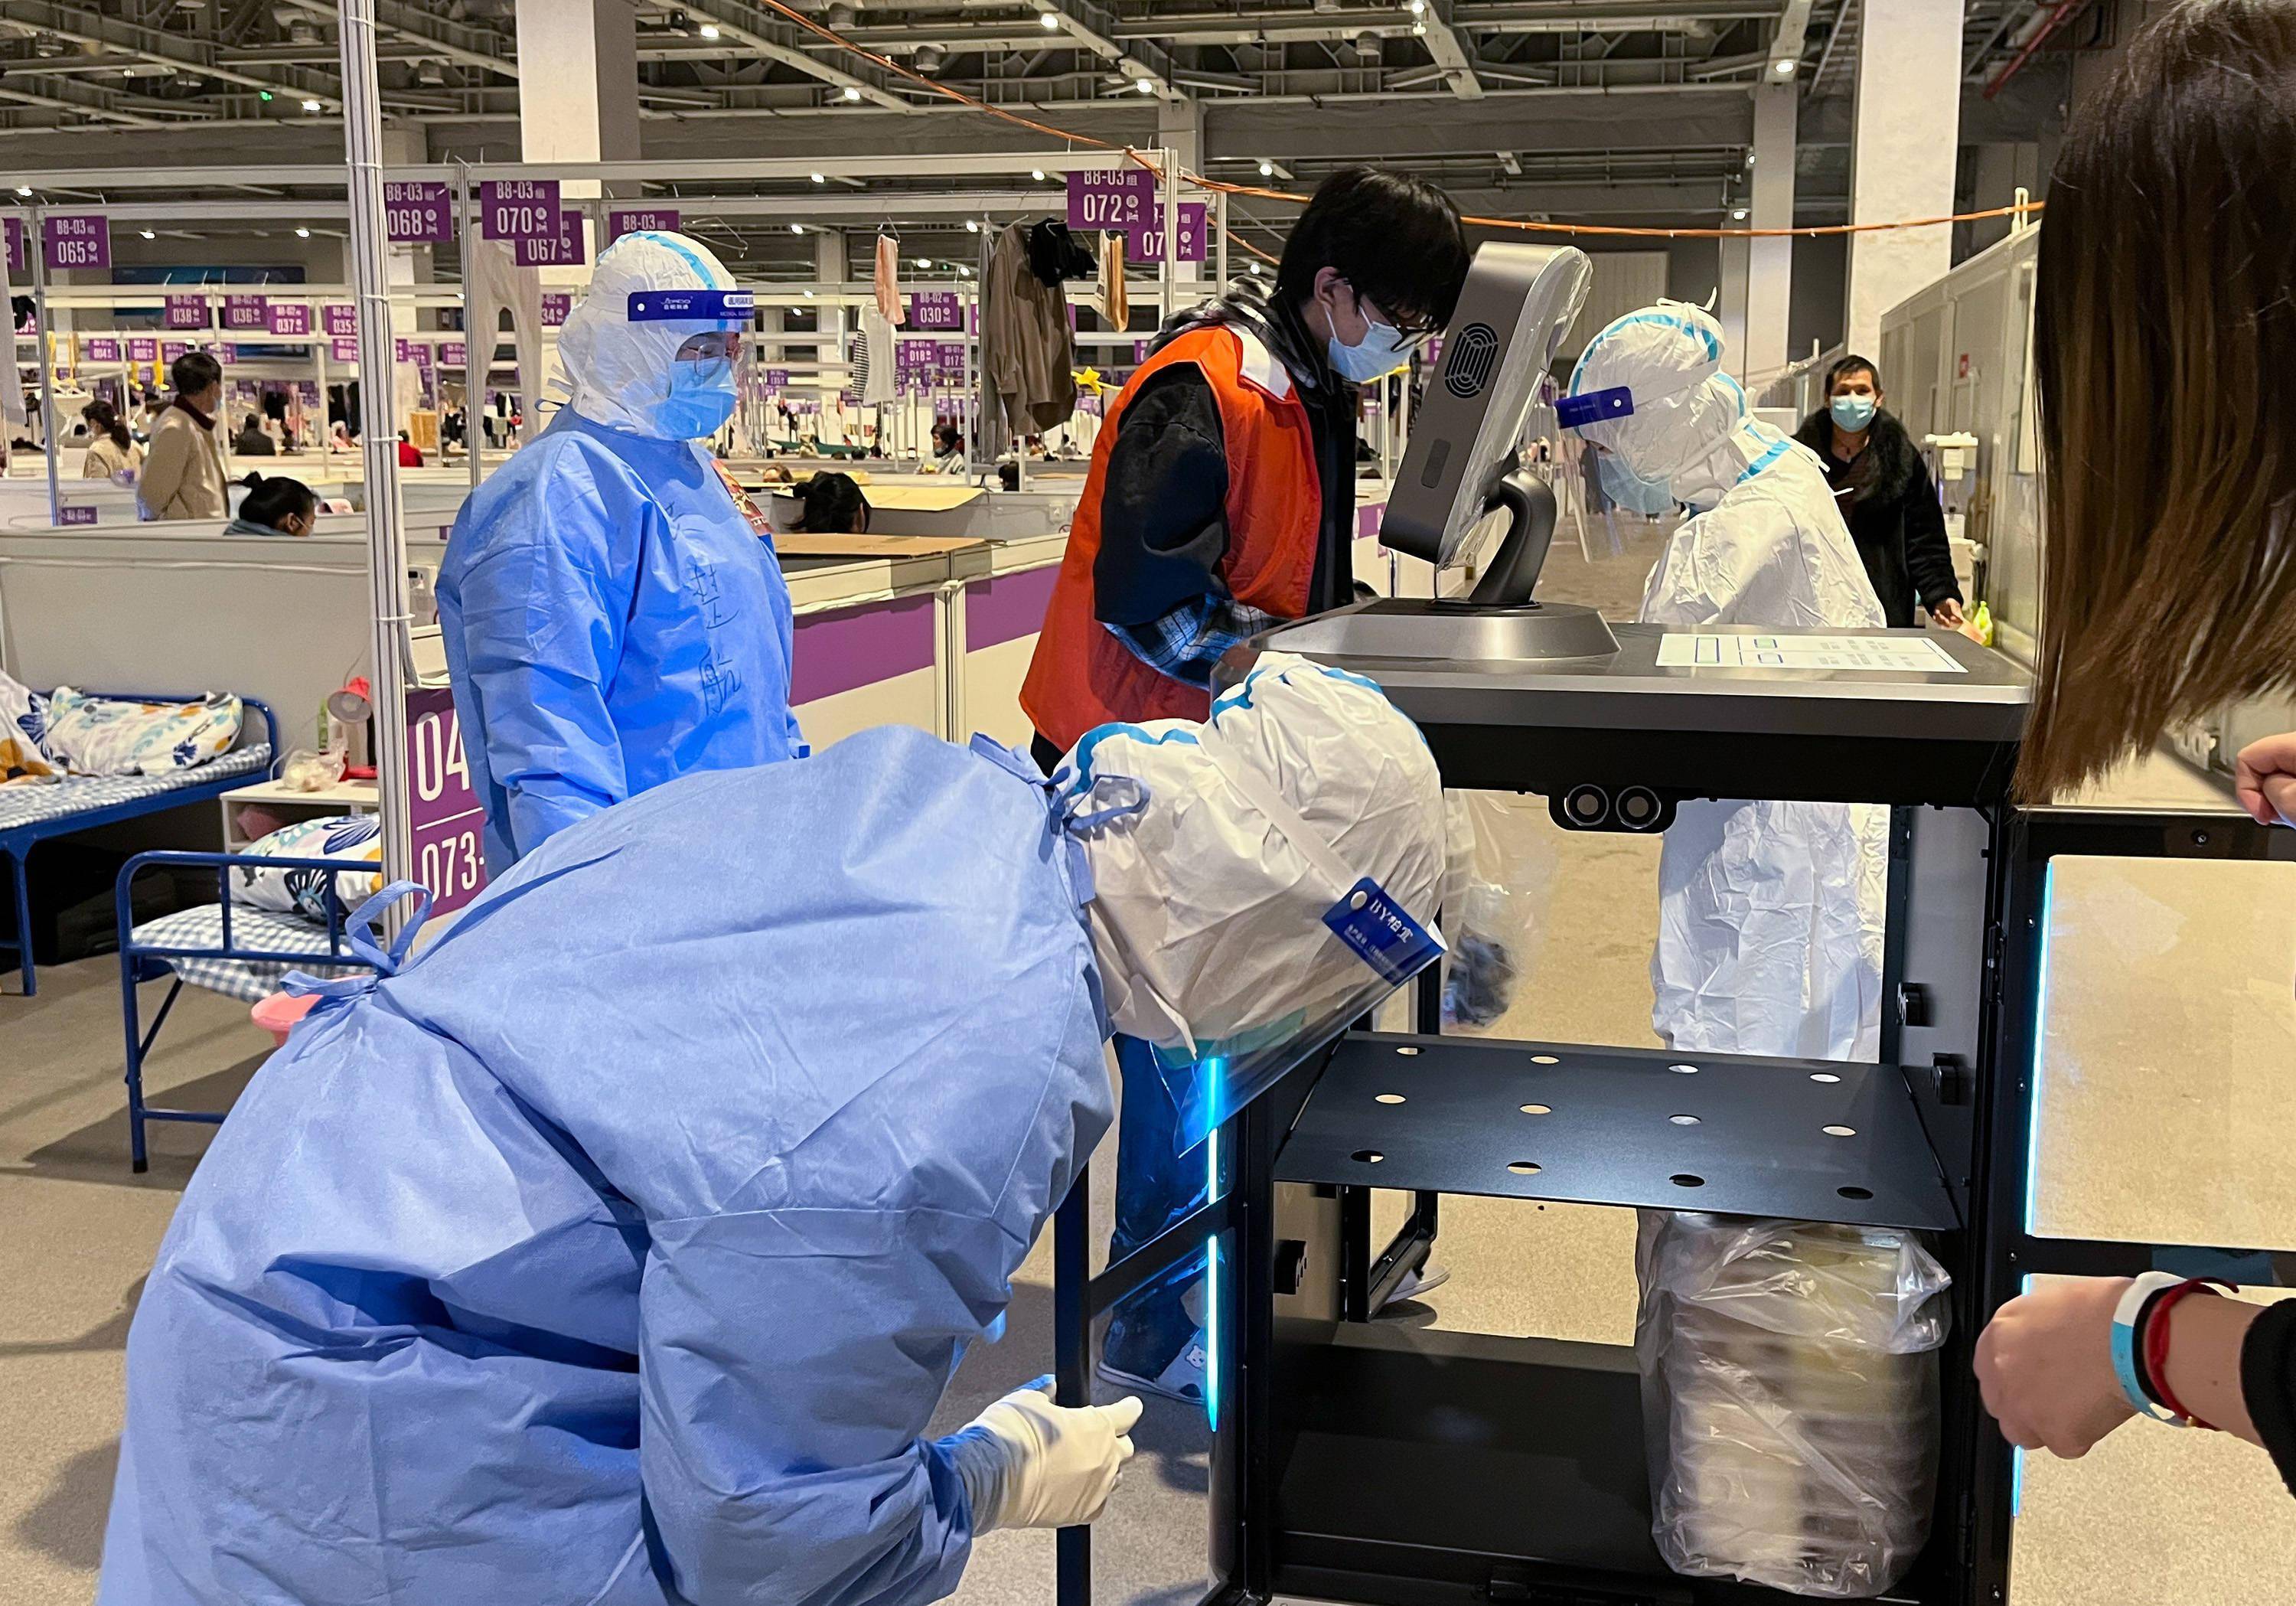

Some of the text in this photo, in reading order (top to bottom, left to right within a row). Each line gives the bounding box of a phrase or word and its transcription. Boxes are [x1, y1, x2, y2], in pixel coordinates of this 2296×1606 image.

[386, 183, 423, 201] B8-03
[497, 181, 533, 199] B8-03
[1084, 194, 1122, 222] 072
[387, 209, 422, 236] 068
[497, 207, 533, 233] 070
[623, 214, 655, 230] B8-03
[57, 241, 86, 263] 065
[527, 239, 557, 260] 067
[1143, 231, 1164, 256] 07
[920, 308, 941, 323] 030
[276, 318, 294, 333] 037
[333, 319, 352, 334] 035
[944, 355, 959, 366] 017
